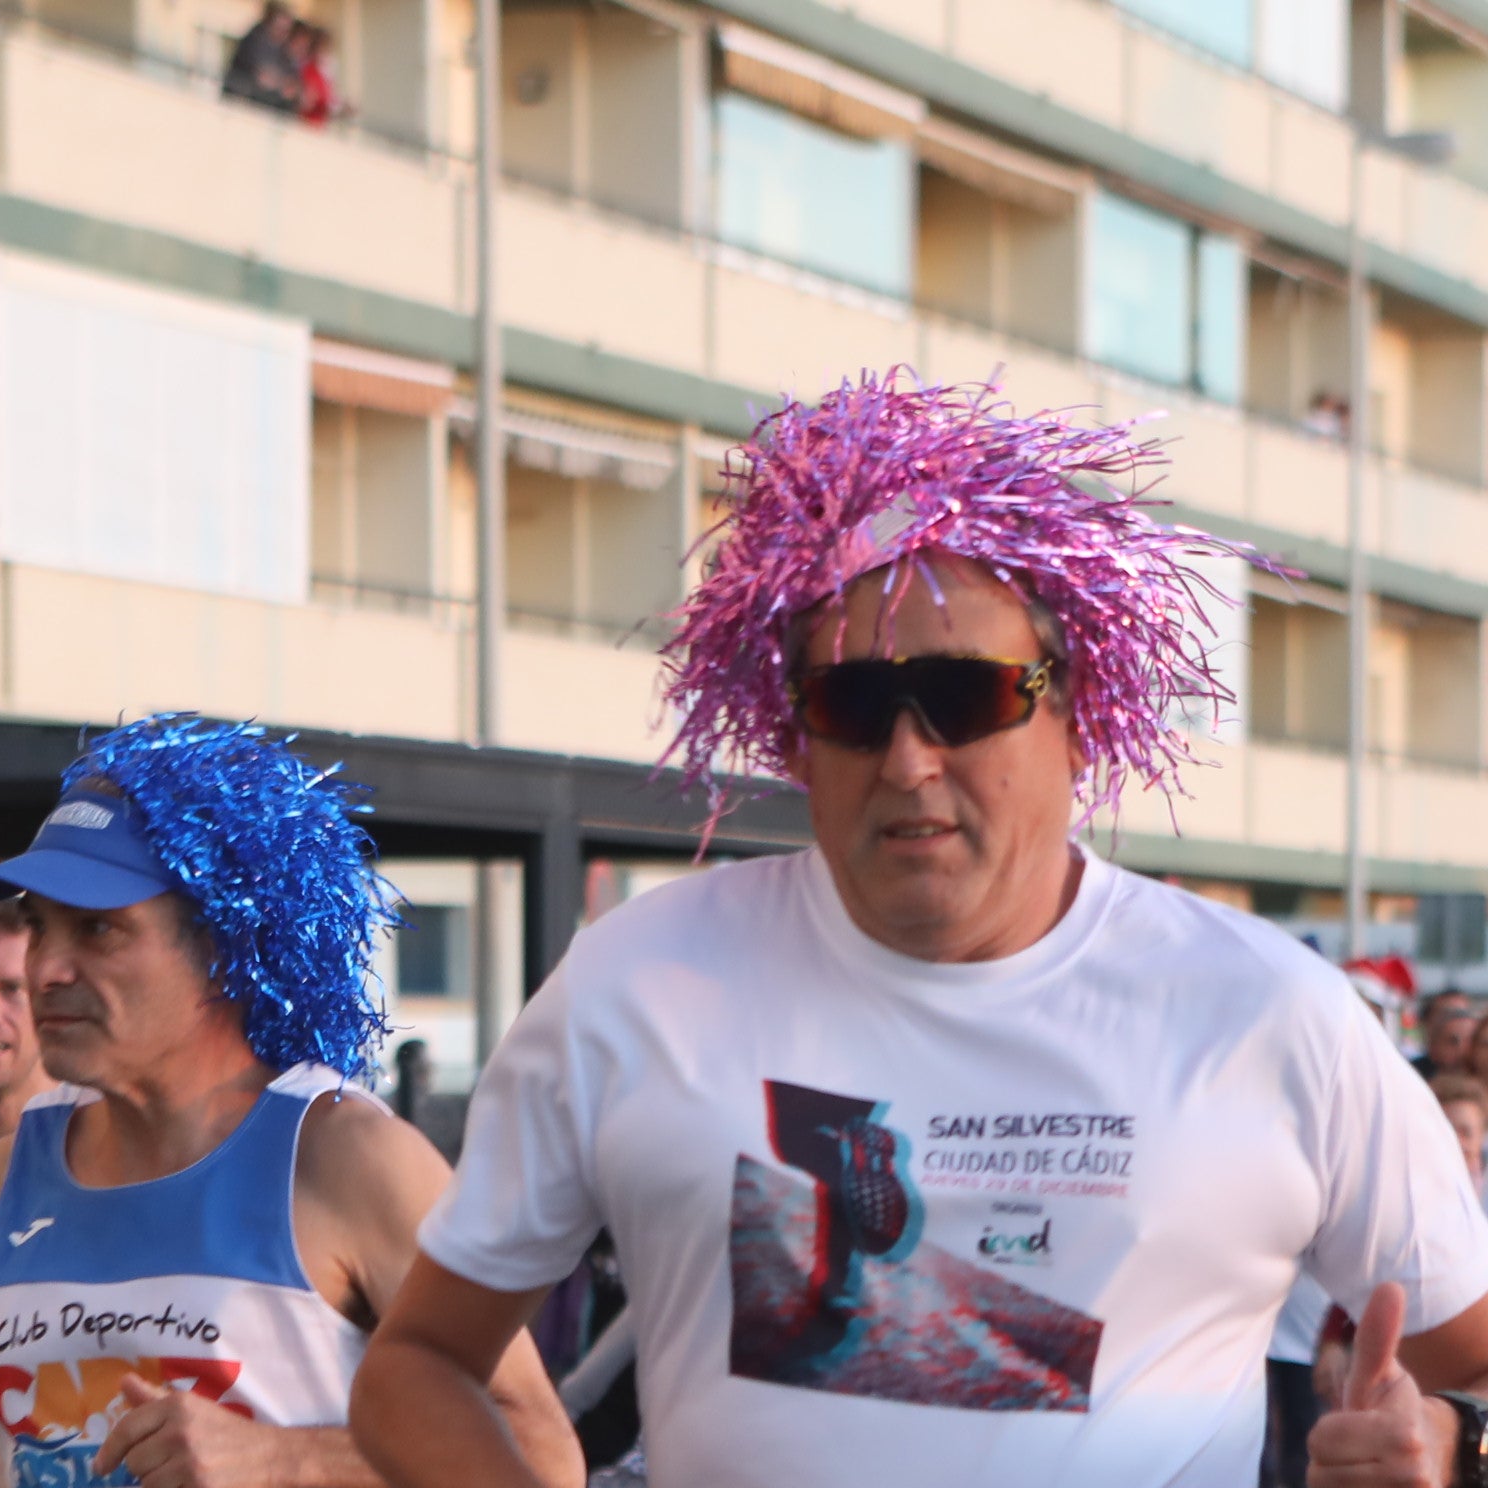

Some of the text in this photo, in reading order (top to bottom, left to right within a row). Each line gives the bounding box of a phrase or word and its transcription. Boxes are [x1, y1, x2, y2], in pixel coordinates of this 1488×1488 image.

[927, 1114, 1136, 1139] SAN SILVESTRE
[923, 1144, 1134, 1178] CIUDAD DE CÁDIZ
[60, 1302, 221, 1350] Deportivo
